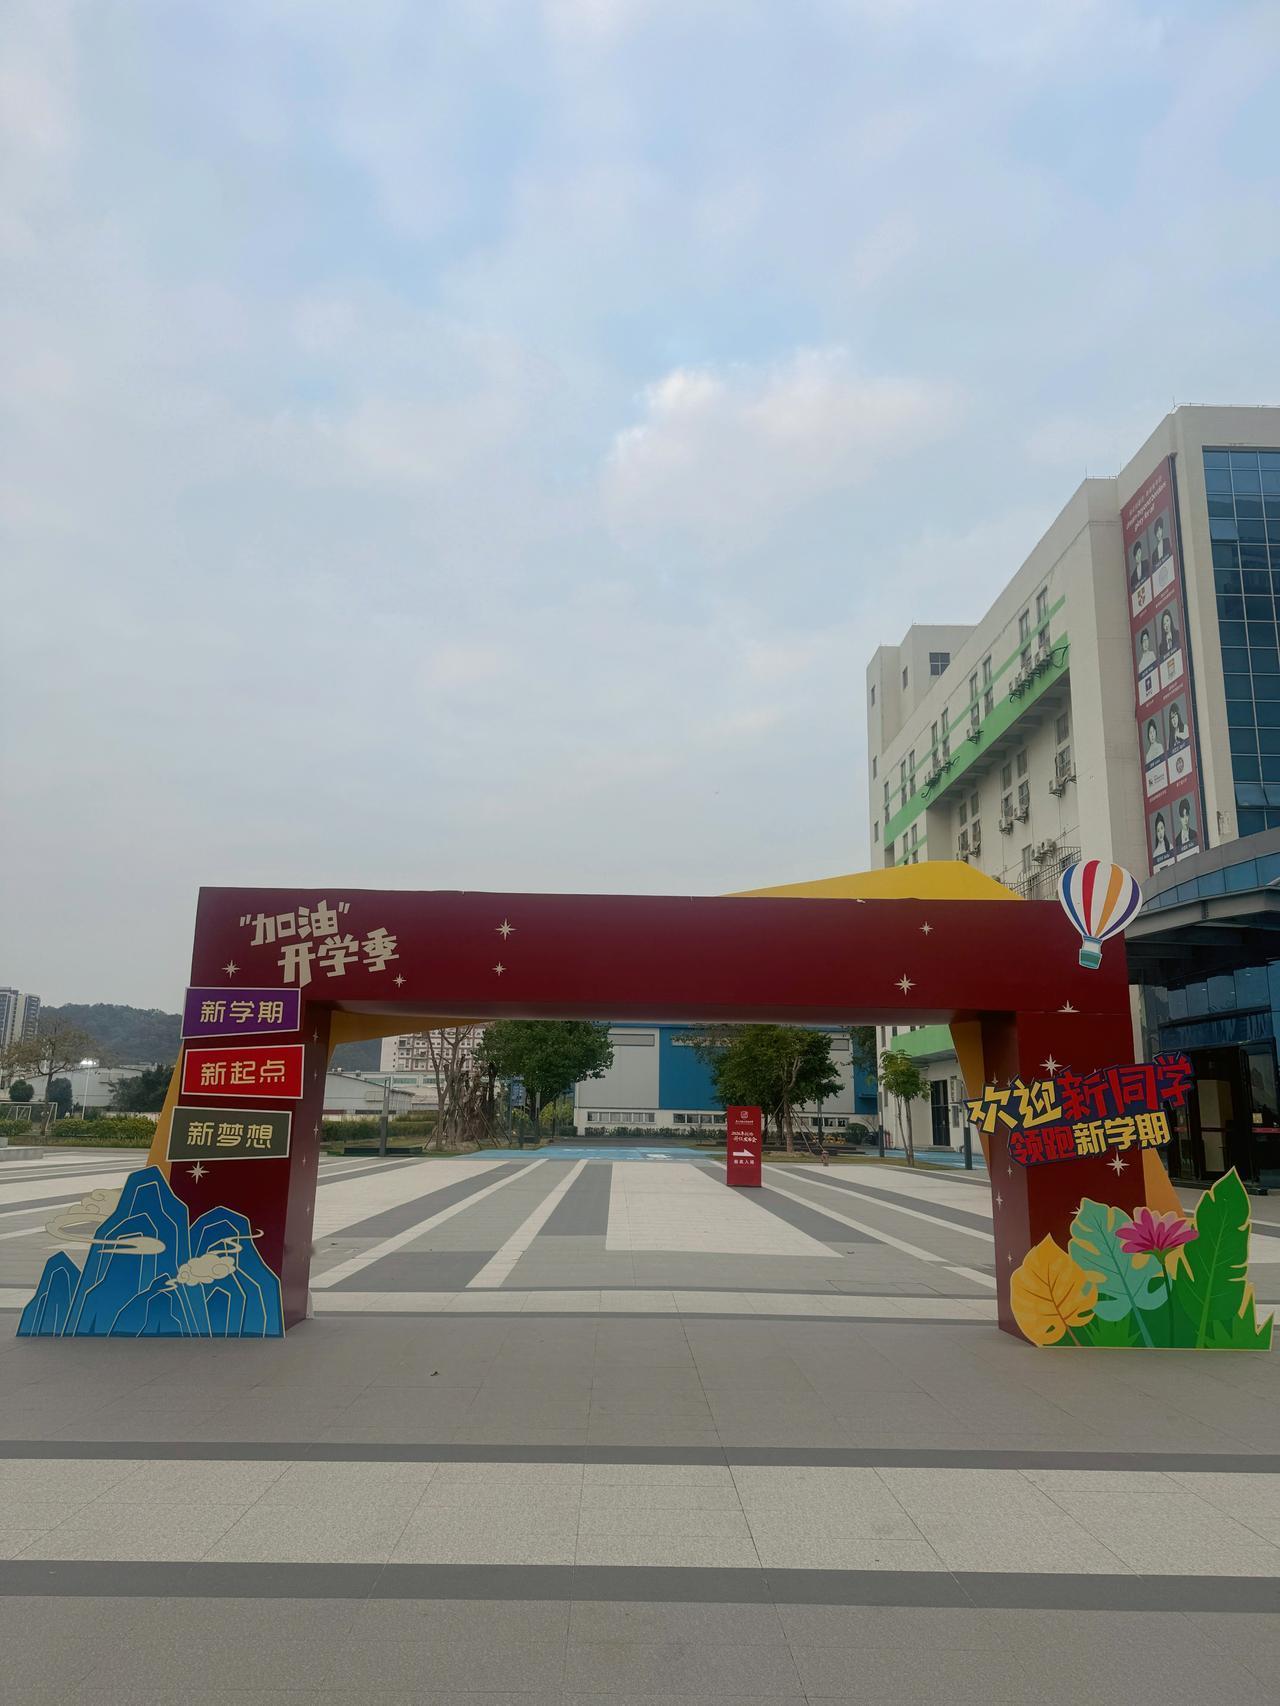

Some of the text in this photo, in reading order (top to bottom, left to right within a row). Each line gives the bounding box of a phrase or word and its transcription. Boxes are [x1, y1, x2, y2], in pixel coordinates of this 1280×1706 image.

[239, 900, 350, 946] "加油"
[277, 927, 399, 988] 开学季
[200, 1000, 283, 1024] 新学期
[200, 1060, 285, 1086] 新起点
[966, 1055, 1192, 1133] 欢迎新同学
[186, 1121, 273, 1149] 新梦想
[1010, 1111, 1171, 1164] 领跑新学期
